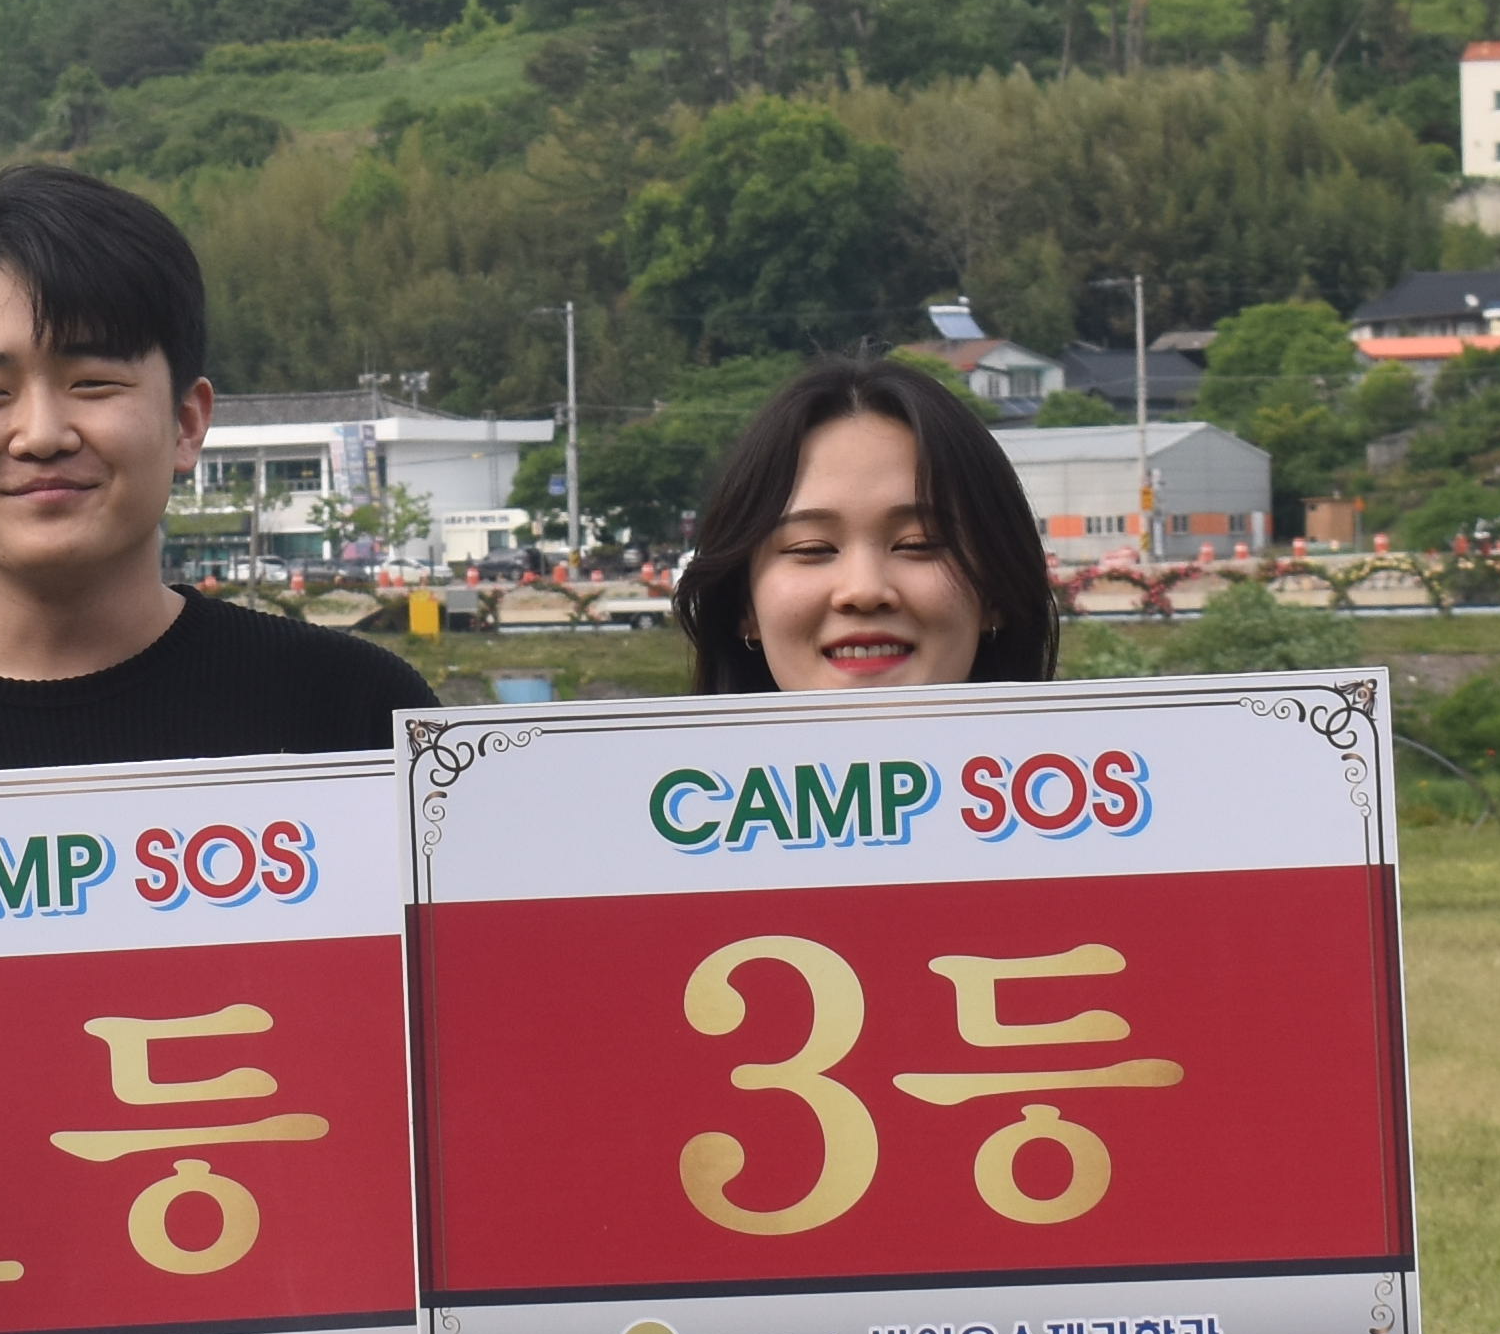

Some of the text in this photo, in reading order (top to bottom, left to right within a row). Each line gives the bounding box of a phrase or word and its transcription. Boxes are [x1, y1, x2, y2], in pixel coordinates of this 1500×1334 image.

[649, 750, 1146, 850] CAMP SOS
[135, 820, 314, 908] SOS
[679, 935, 1184, 1236] 3등
